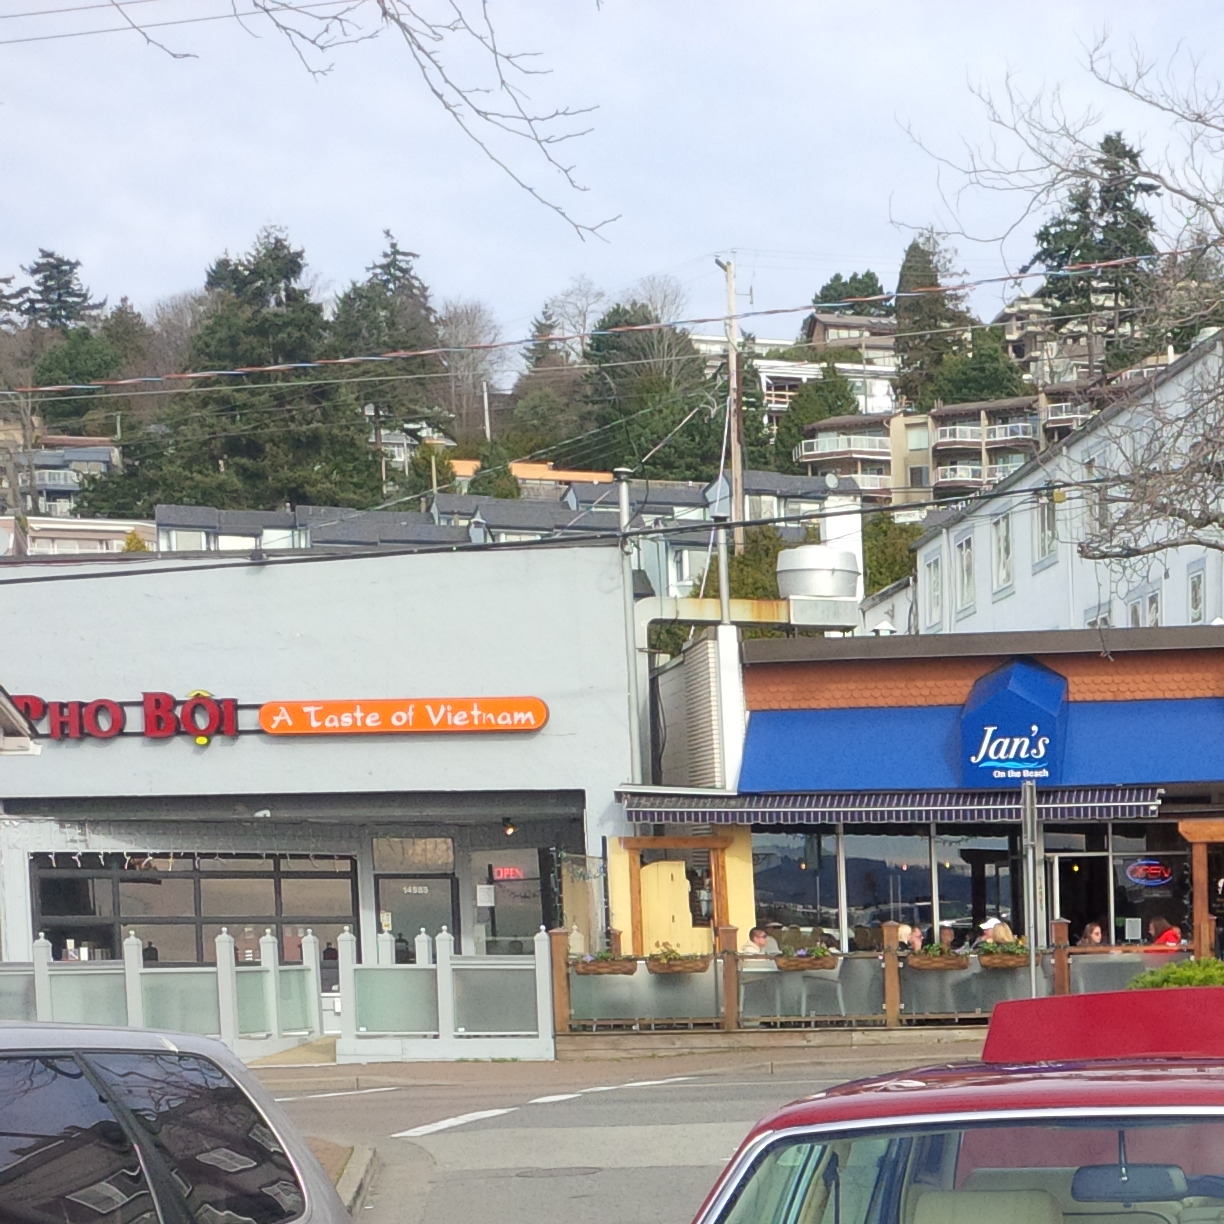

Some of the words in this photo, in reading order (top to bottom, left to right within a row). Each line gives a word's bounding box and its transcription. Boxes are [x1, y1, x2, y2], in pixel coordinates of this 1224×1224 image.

[271, 706, 293, 728] A
[302, 705, 381, 728] Taste
[391, 705, 415, 727] of
[425, 702, 535, 726] Vietnam
[971, 725, 1050, 763] Jan's
[993, 770, 1006, 778] On
[1007, 769, 1021, 778] the
[1023, 768, 1049, 778] Beach
[494, 867, 524, 880] OPEN
[1131, 865, 1172, 879] OPEN
